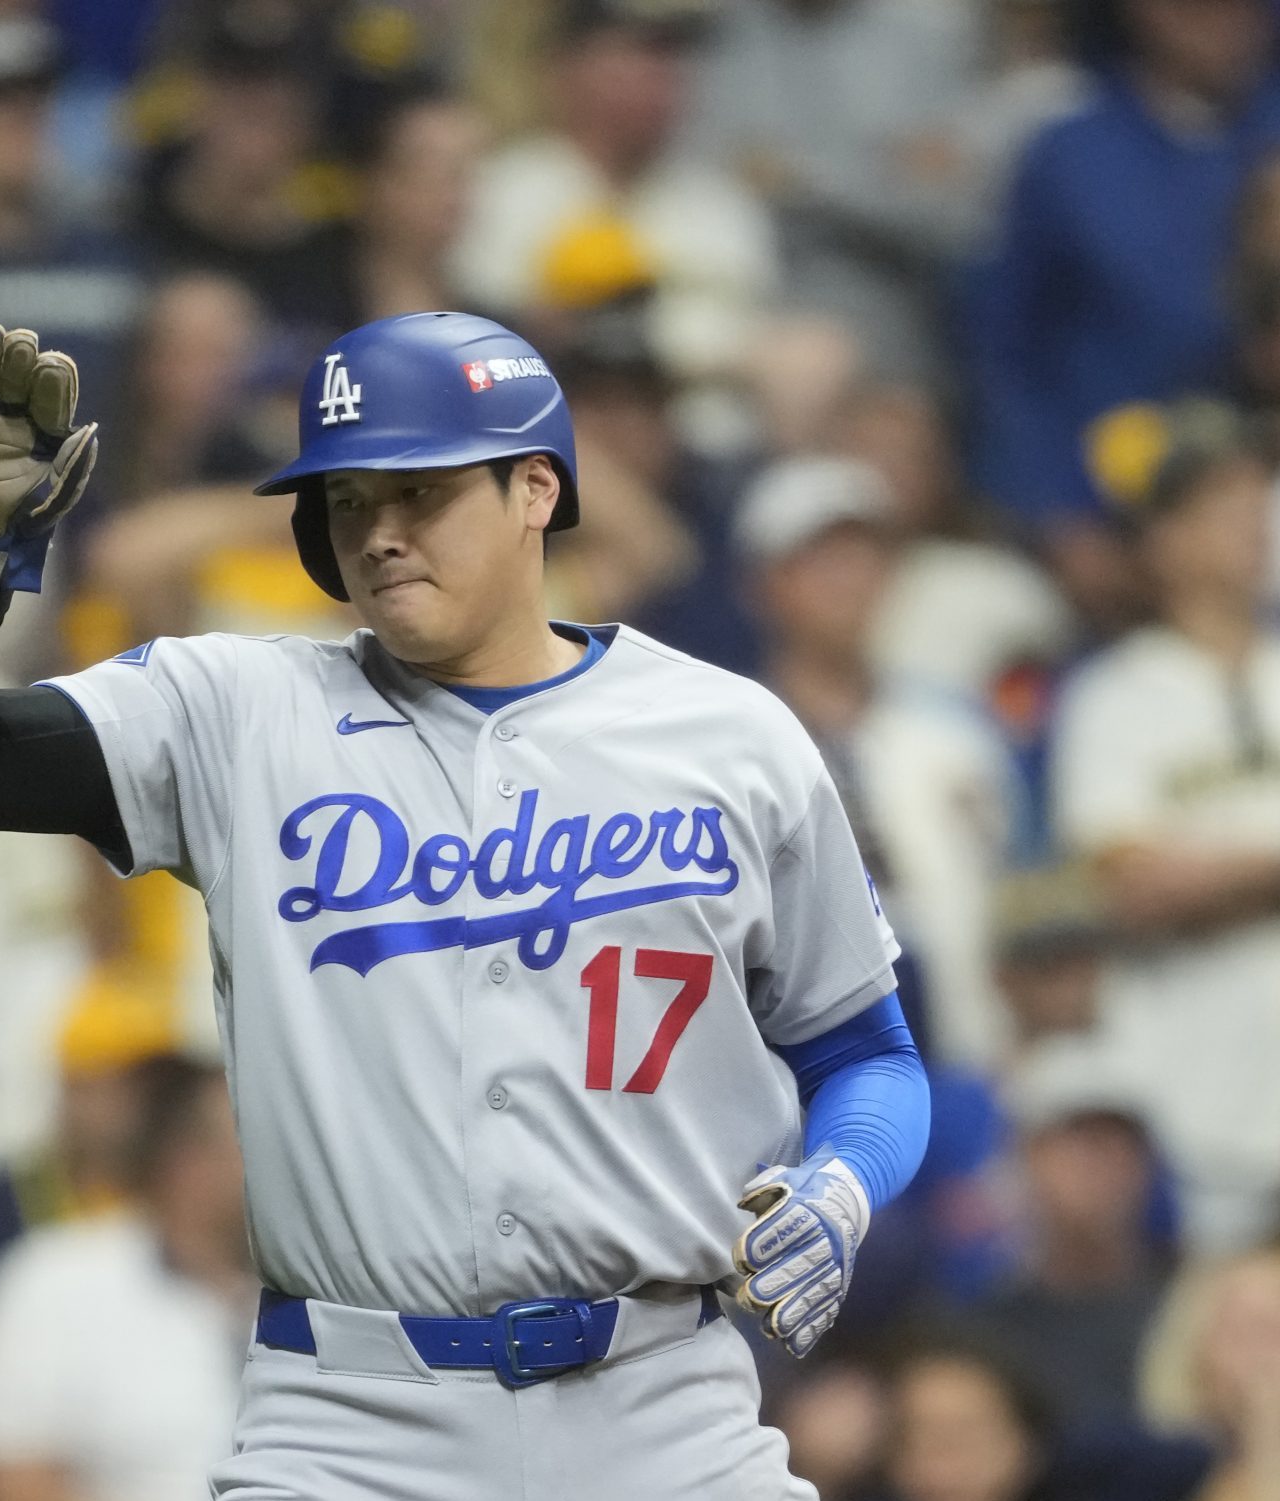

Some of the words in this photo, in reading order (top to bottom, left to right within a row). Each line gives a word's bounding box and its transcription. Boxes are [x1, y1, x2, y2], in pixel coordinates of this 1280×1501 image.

[319, 352, 361, 426] LA
[487, 357, 551, 382] STRAUS
[279, 788, 739, 971] Dodgers
[580, 945, 713, 1094] 17
